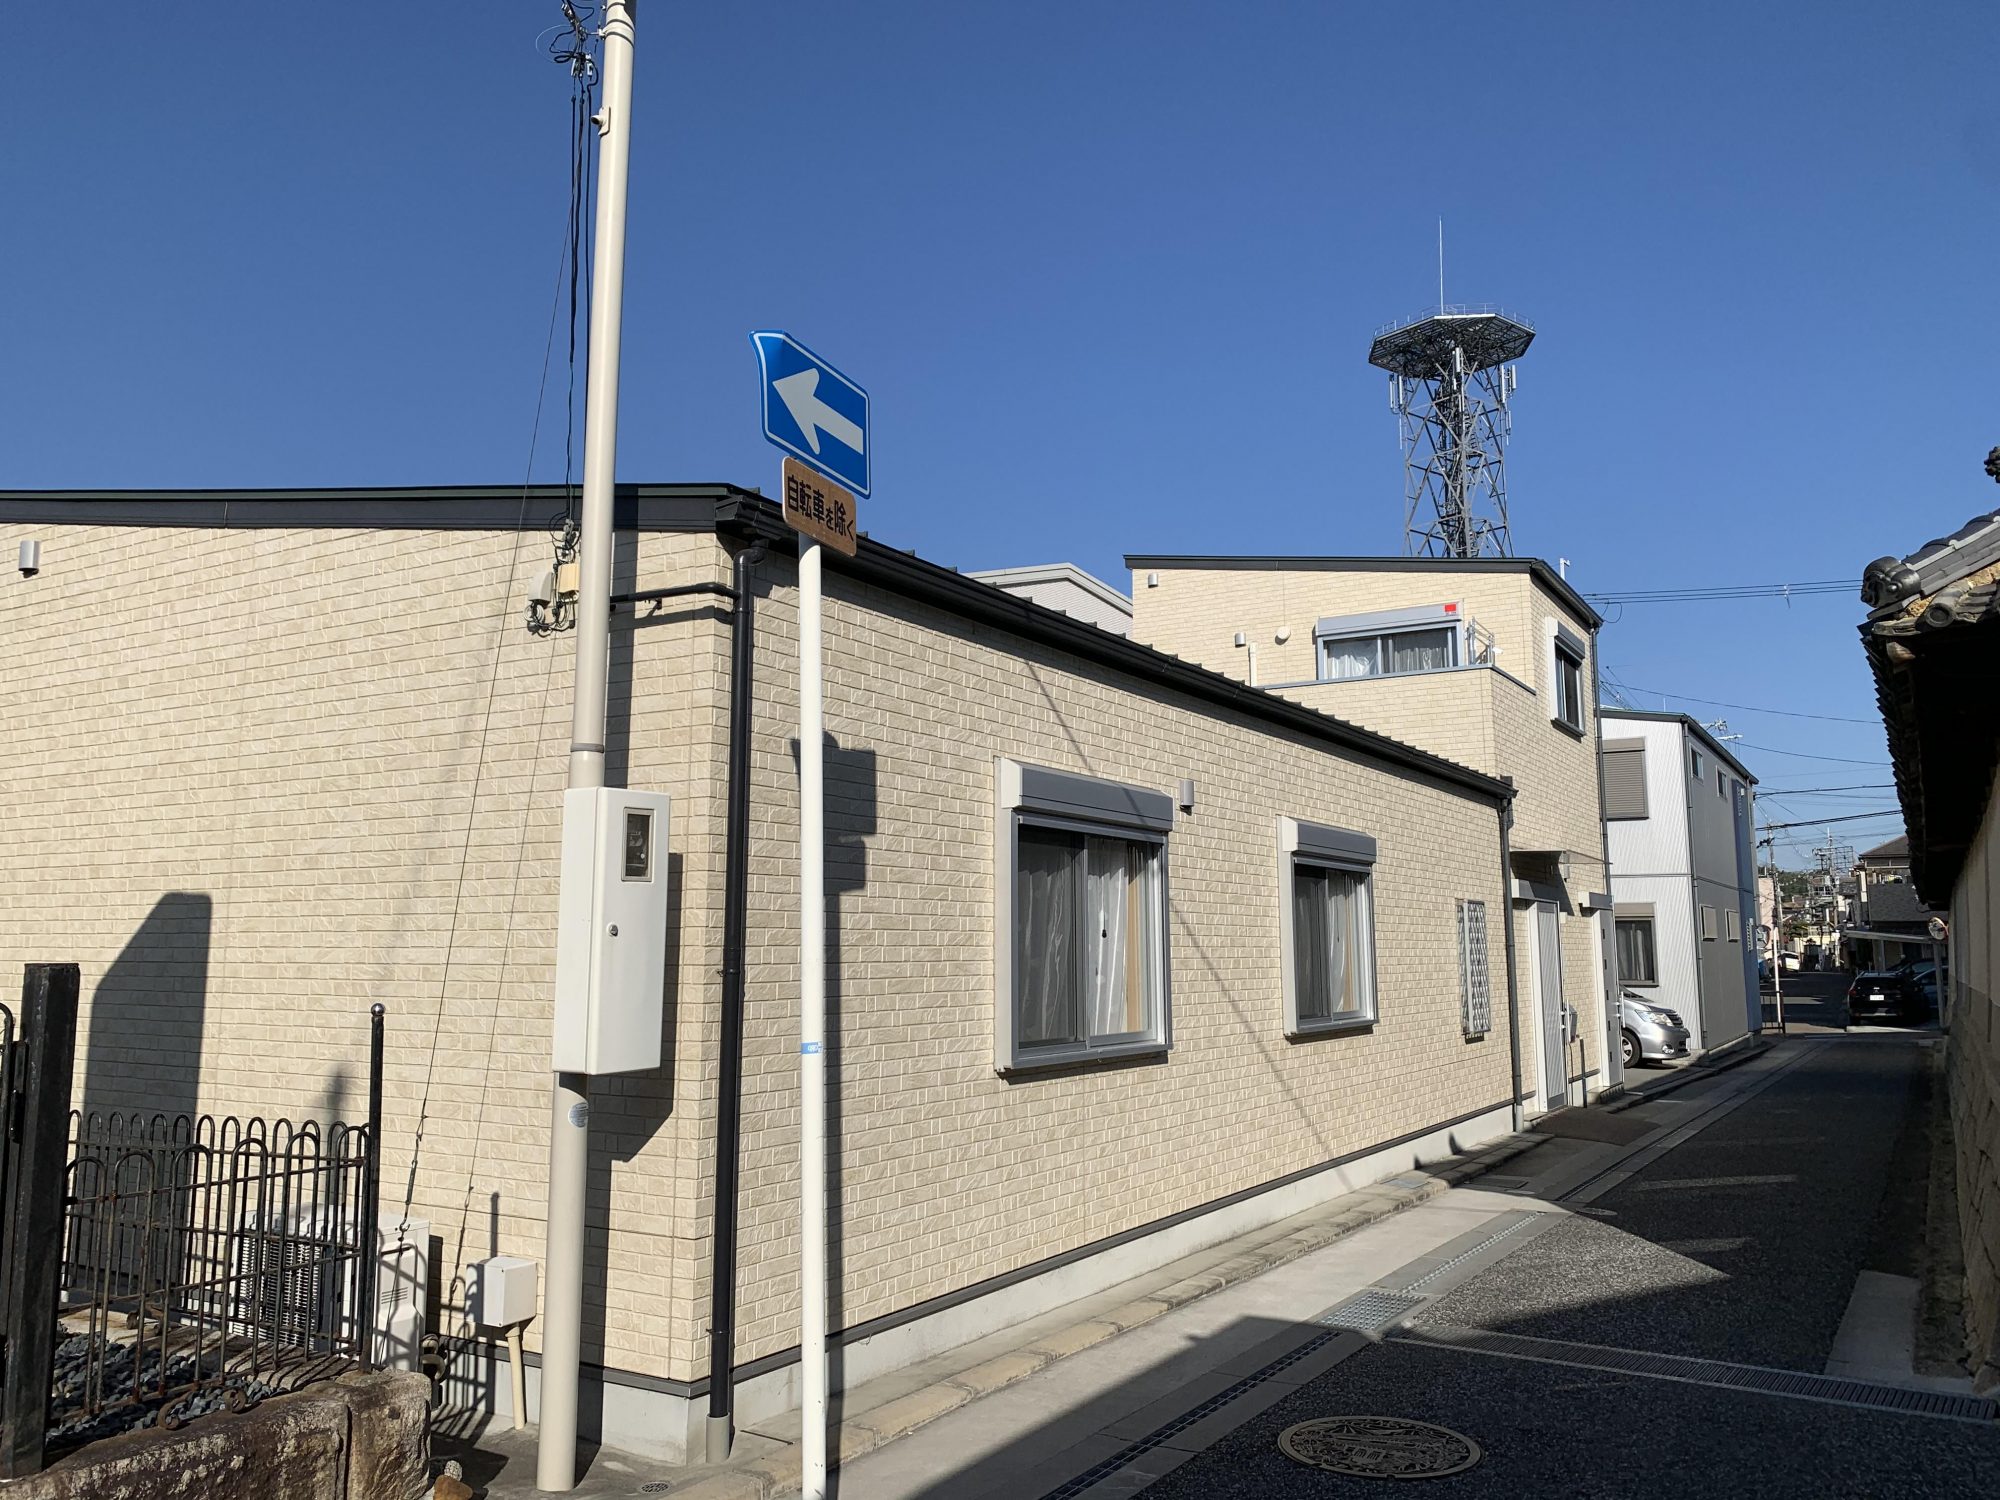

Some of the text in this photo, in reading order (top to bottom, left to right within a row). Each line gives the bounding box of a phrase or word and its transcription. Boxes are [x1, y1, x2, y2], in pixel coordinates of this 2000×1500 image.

[787, 474, 854, 541] 自転車を除く
